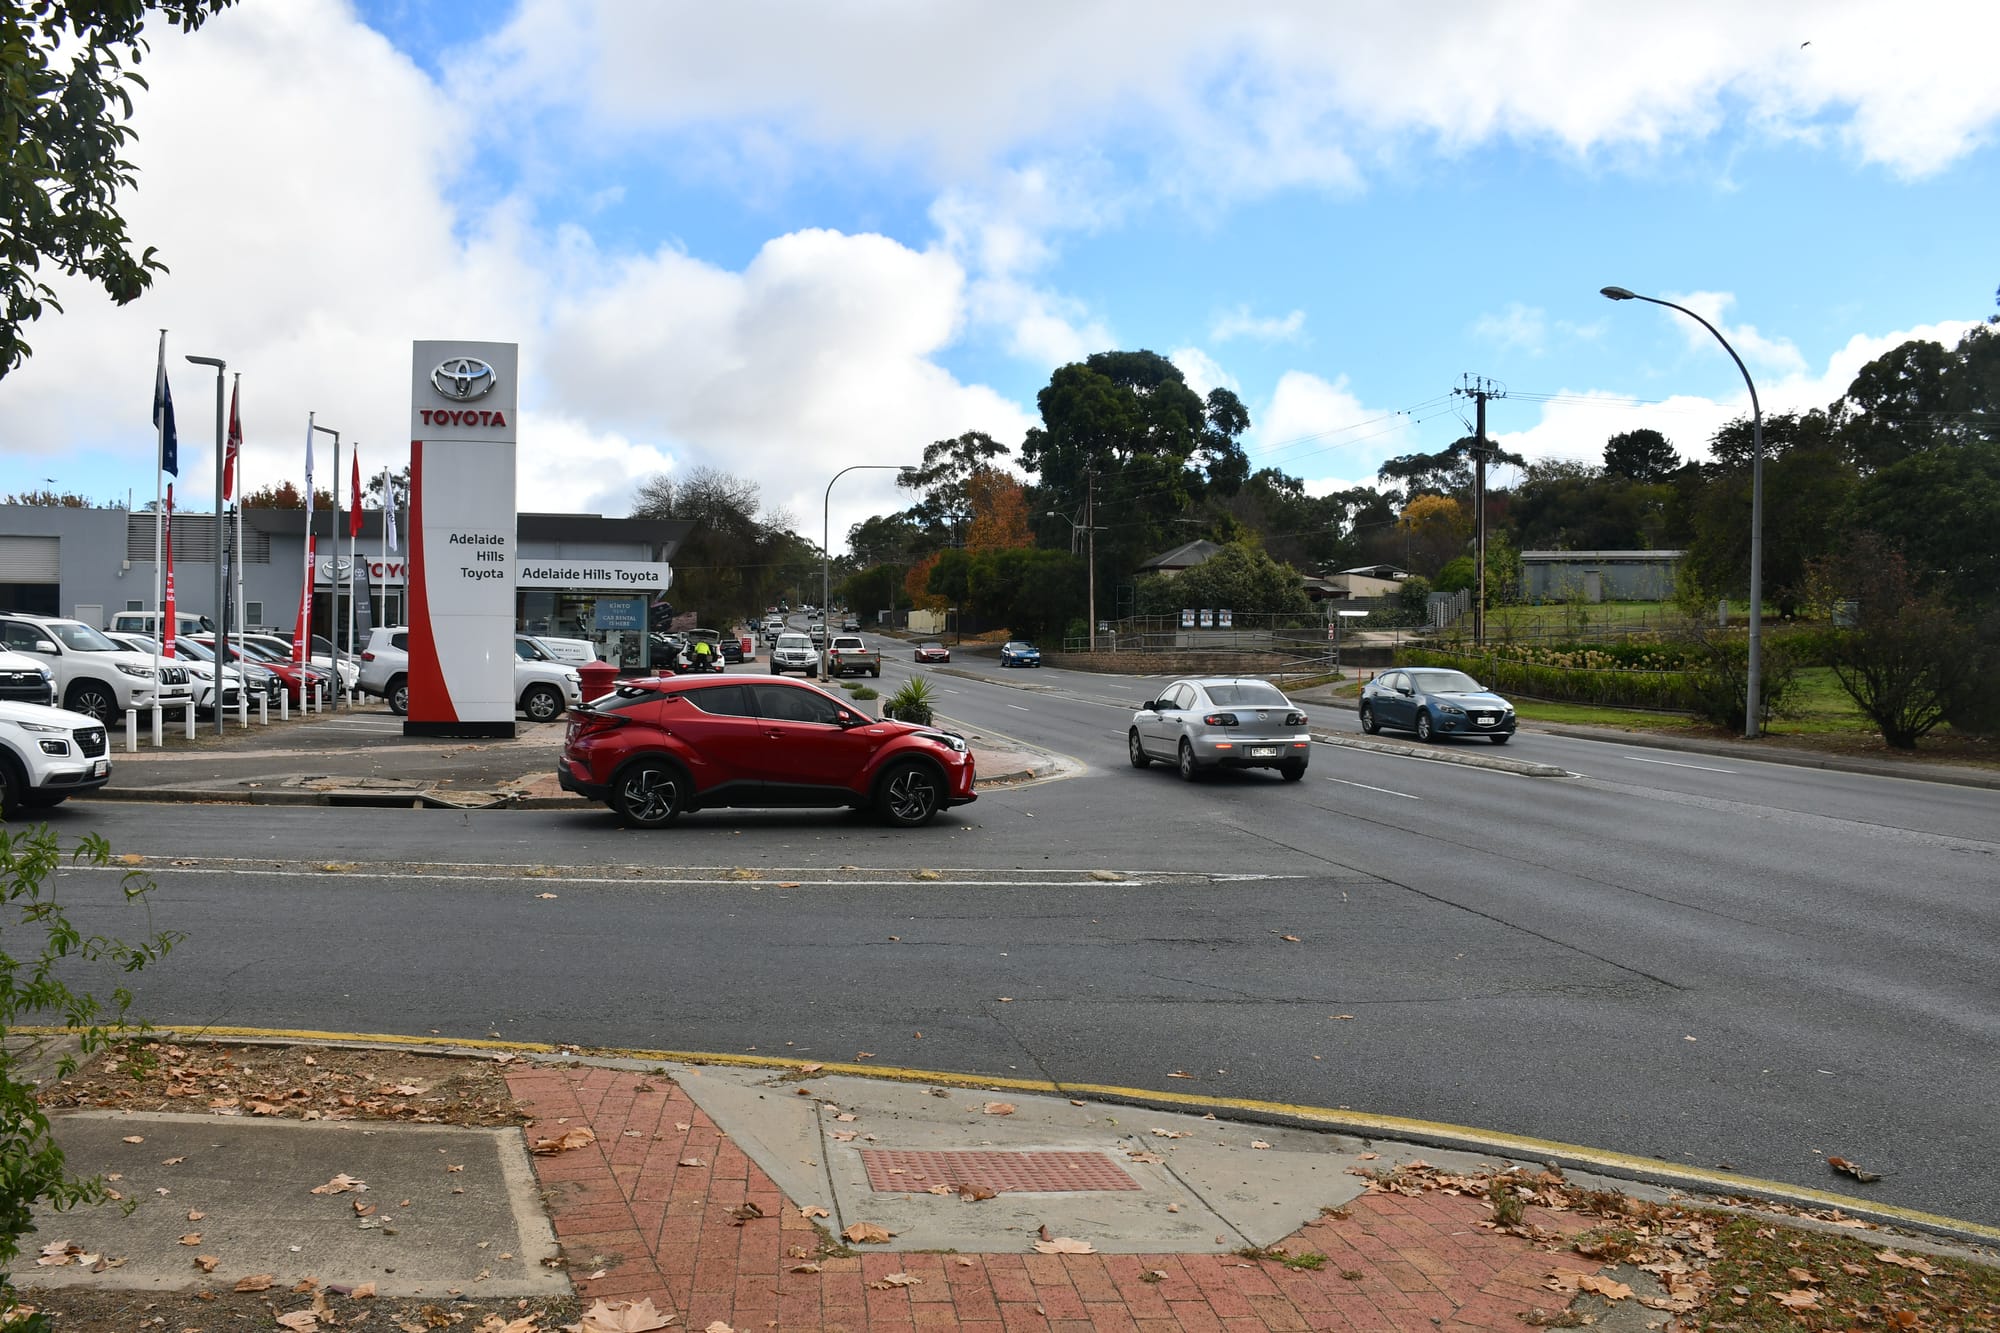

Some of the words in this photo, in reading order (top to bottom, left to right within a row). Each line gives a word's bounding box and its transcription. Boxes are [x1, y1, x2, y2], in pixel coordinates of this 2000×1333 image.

[420, 409, 506, 427] TOYOTA
[449, 533, 505, 545] Adelaide
[476, 551, 505, 562] Hills
[461, 568, 504, 581] Toyota
[522, 568, 580, 580] Adelaide
[583, 568, 612, 580] Hills
[614, 569, 659, 583] Toyota
